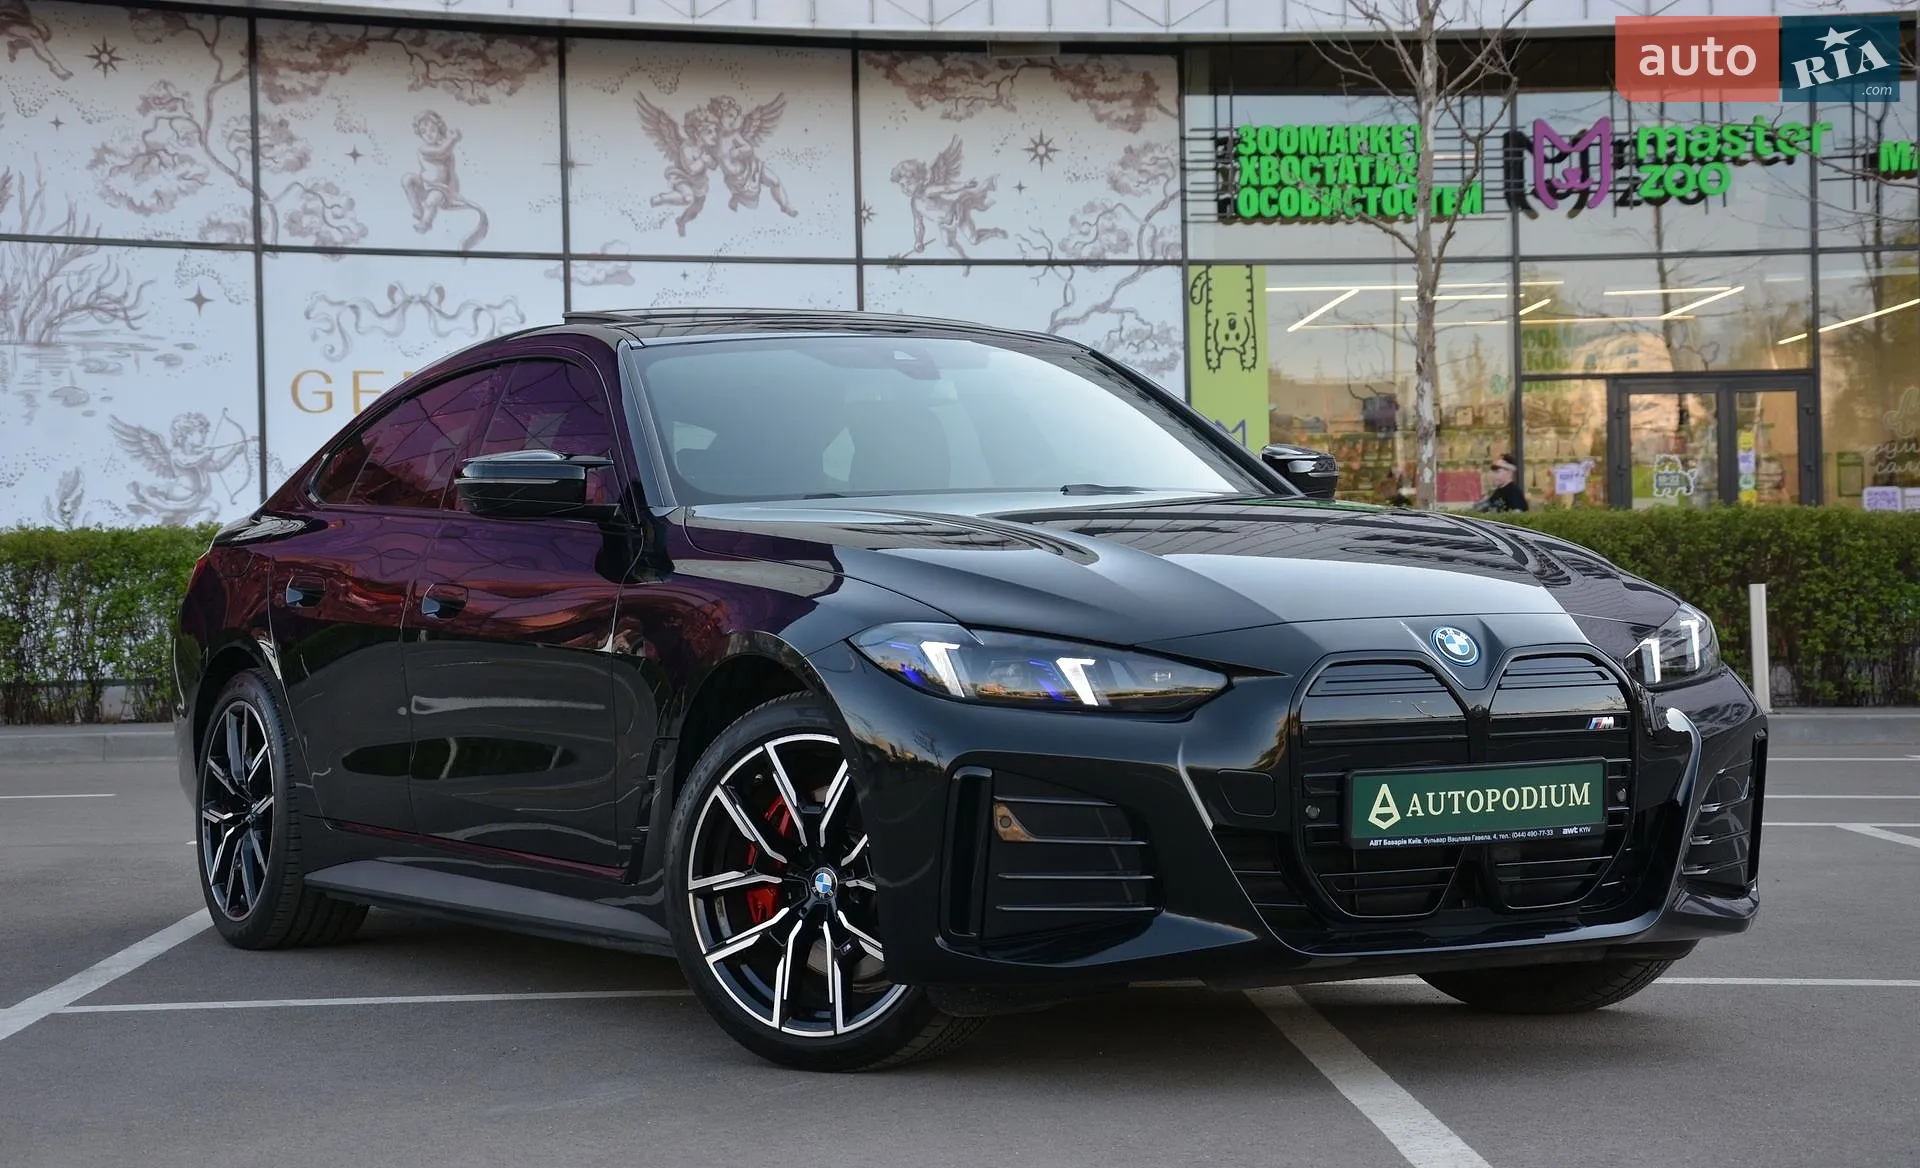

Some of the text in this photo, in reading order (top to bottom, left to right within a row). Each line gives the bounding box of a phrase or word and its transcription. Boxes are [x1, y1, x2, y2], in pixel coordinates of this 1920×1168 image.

[1636, 115, 1833, 159] master
[1238, 154, 1419, 186] ХВОСТАТИХ
[1636, 162, 1732, 198] zoo
[291, 369, 415, 414] GE
[1406, 782, 1591, 817] AUTOPODIUM
[1512, 831, 1526, 839] (044)
[1562, 826, 1578, 835] awt
